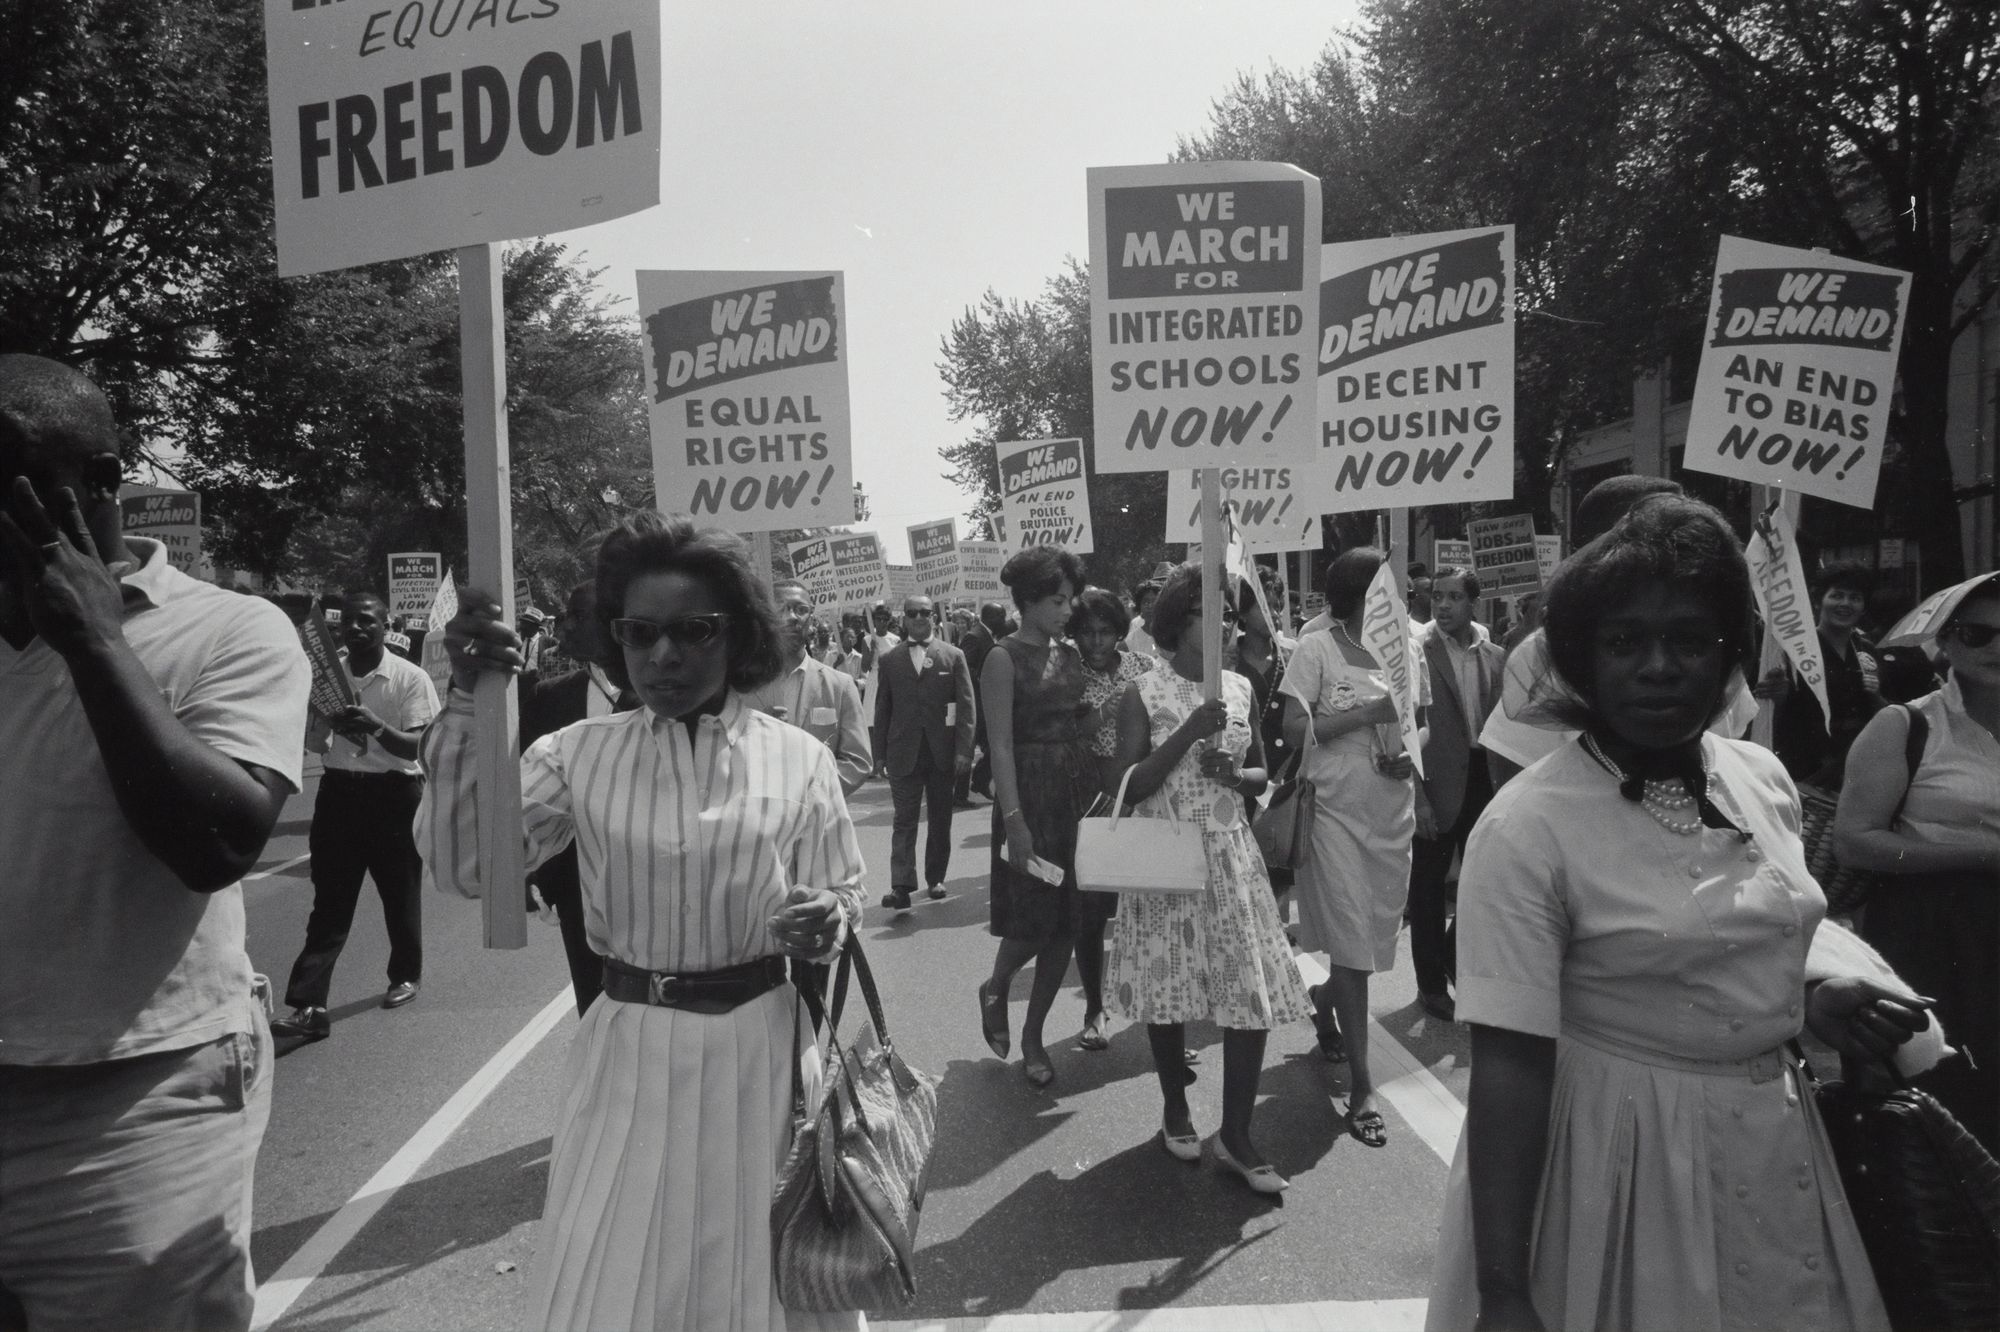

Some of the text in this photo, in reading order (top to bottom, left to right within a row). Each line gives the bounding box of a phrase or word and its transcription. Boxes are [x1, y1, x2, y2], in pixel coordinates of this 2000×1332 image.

[360, 0, 560, 57] EQUALS
[298, 30, 642, 200] FREEDOM
[1176, 191, 1235, 222] WE
[1122, 225, 1288, 268] MARCH
[1175, 270, 1240, 290] FOR
[1367, 252, 1440, 306] WE
[1777, 272, 1847, 303] WE
[710, 290, 776, 335] WE
[1320, 277, 1498, 364] DEMAND
[1724, 305, 1890, 340] DEMAND
[1108, 304, 1303, 344] INTEGRATED
[666, 317, 831, 388] DEMAND
[1110, 352, 1300, 392] SCHOOLS
[1337, 361, 1487, 404] DECENT
[1724, 354, 1878, 406] AN END
[685, 395, 822, 428] EQUAL
[1125, 394, 1293, 451] NOW!
[1724, 387, 1870, 442] TO BIAS
[1322, 404, 1501, 448] HOUSING
[685, 432, 828, 466] RIGHTS
[1027, 446, 1056, 467] WE
[1717, 424, 1865, 481] NOW!
[1009, 456, 1078, 492] DEMAND
[1334, 435, 1493, 492] NOW!
[690, 464, 834, 516] NOW!
[1191, 468, 1291, 490] RGHTS
[145, 496, 173, 510] WE
[1016, 490, 1075, 504] AN END
[128, 508, 194, 527] DEMAND
[1020, 516, 1074, 530] BRUTALITY
[1030, 506, 1066, 518] POLICE
[926, 528, 939, 537] WE
[1020, 523, 1084, 548] NOW!
[1474, 524, 1500, 534] UAW
[807, 541, 825, 557] WE
[836, 545, 874, 560] MARCH
[846, 539, 860, 548] WE
[916, 534, 952, 552] MARCH
[1474, 532, 1514, 551] JOBS
[396, 565, 434, 574] MARCH
[797, 552, 831, 573] DEMA
[836, 562, 882, 577] INTEGRATED
[916, 560, 936, 572] FIRST
[938, 554, 958, 568] CLASS
[1476, 548, 1536, 569] FREEDOM
[803, 572, 817, 580] AN
[838, 573, 884, 588] SCHOOLS
[916, 564, 960, 583] CITIZENSHIP
[845, 583, 884, 601] NOW!
[924, 577, 959, 598] NOW!
[964, 580, 998, 590] REEDOM
[396, 600, 436, 610] NOW!
[304, 618, 329, 661] MARCH
[1364, 586, 1407, 696] FREEDOM
[1794, 641, 1806, 656] IN
[322, 682, 344, 713] FREEDO
